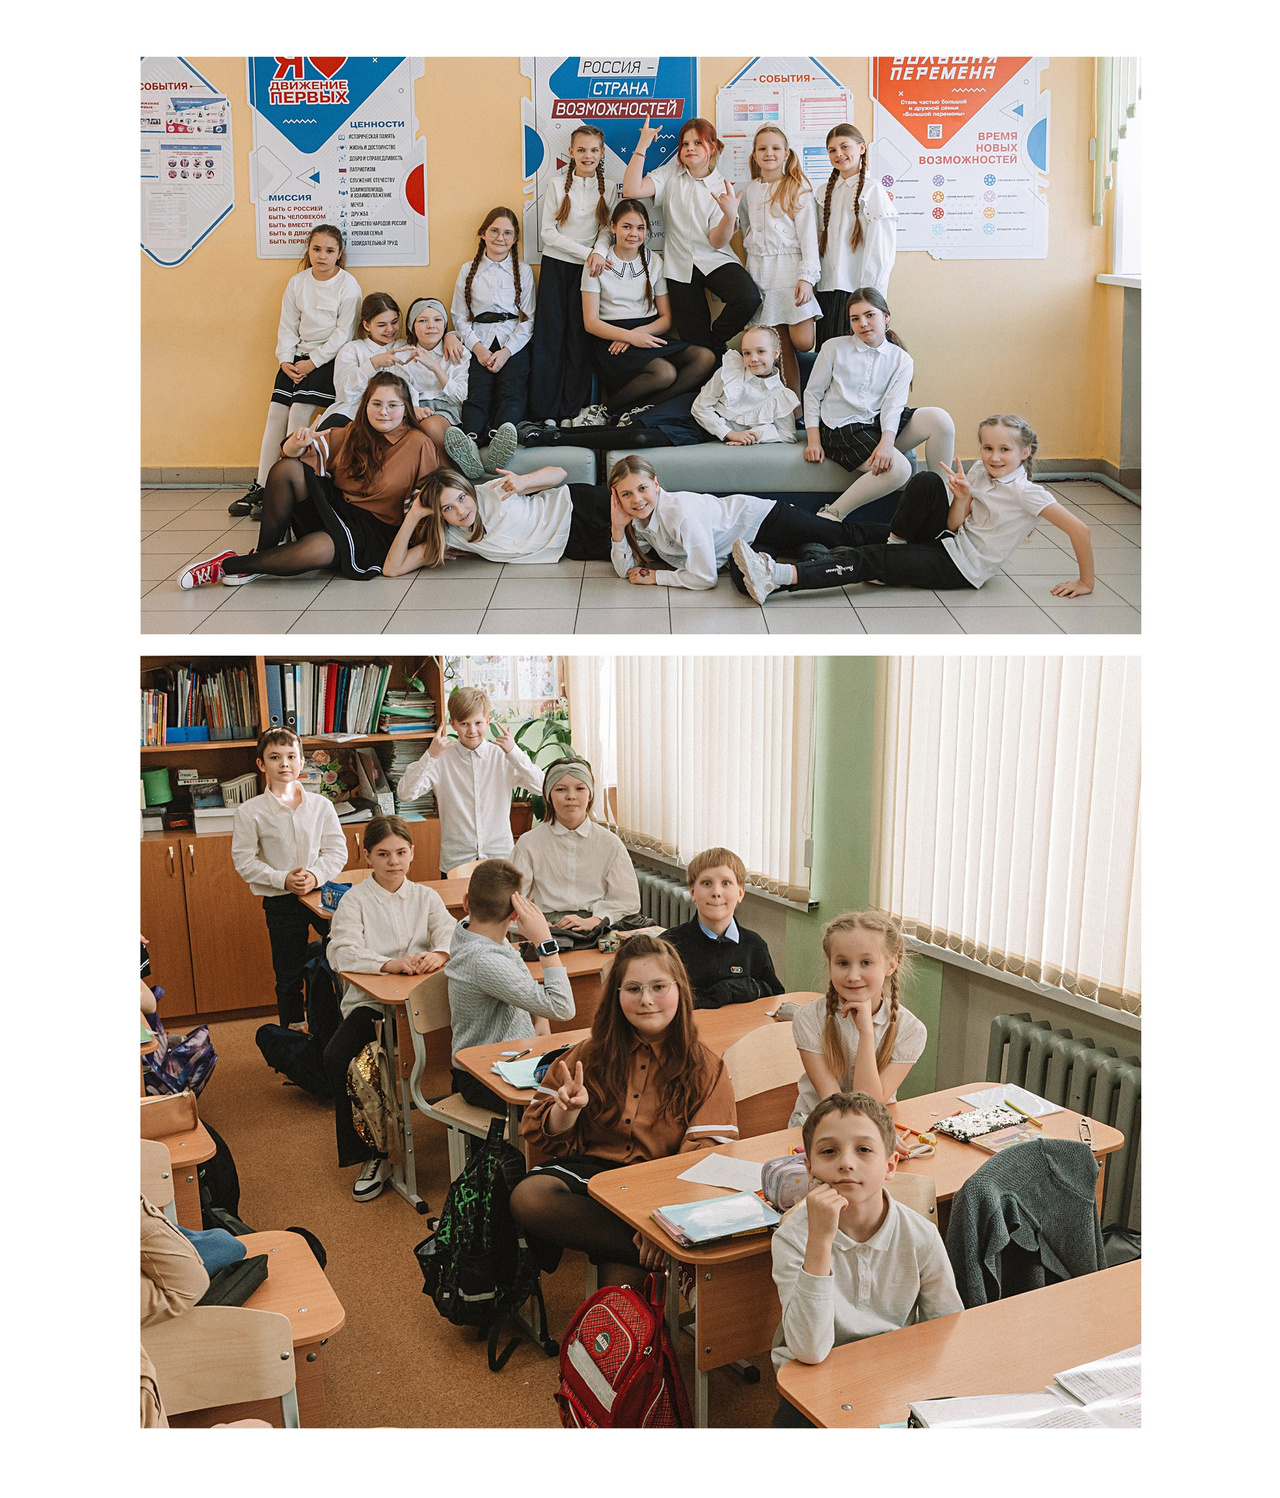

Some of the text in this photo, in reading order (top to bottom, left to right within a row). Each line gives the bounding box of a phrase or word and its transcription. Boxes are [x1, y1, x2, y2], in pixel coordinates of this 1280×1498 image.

[582, 61, 642, 74] РОССИЯ
[889, 66, 996, 80] ПЕРЕМЕНА
[759, 75, 811, 83] СОБЫТИЯ
[269, 81, 347, 91] ДВИЖЕНИЕ
[592, 82, 649, 96] СТРАНА
[270, 91, 348, 103] ПЕРВЫХ
[555, 100, 678, 116] ВОЗМОЖНОСТЕЙ
[350, 121, 405, 129] ЦЕННОСТИ
[978, 132, 1018, 140] ВРЕМЯ
[976, 144, 1017, 152] НОВЫХ
[918, 154, 1017, 164] ВОЗМОЖНОСТЕЙ
